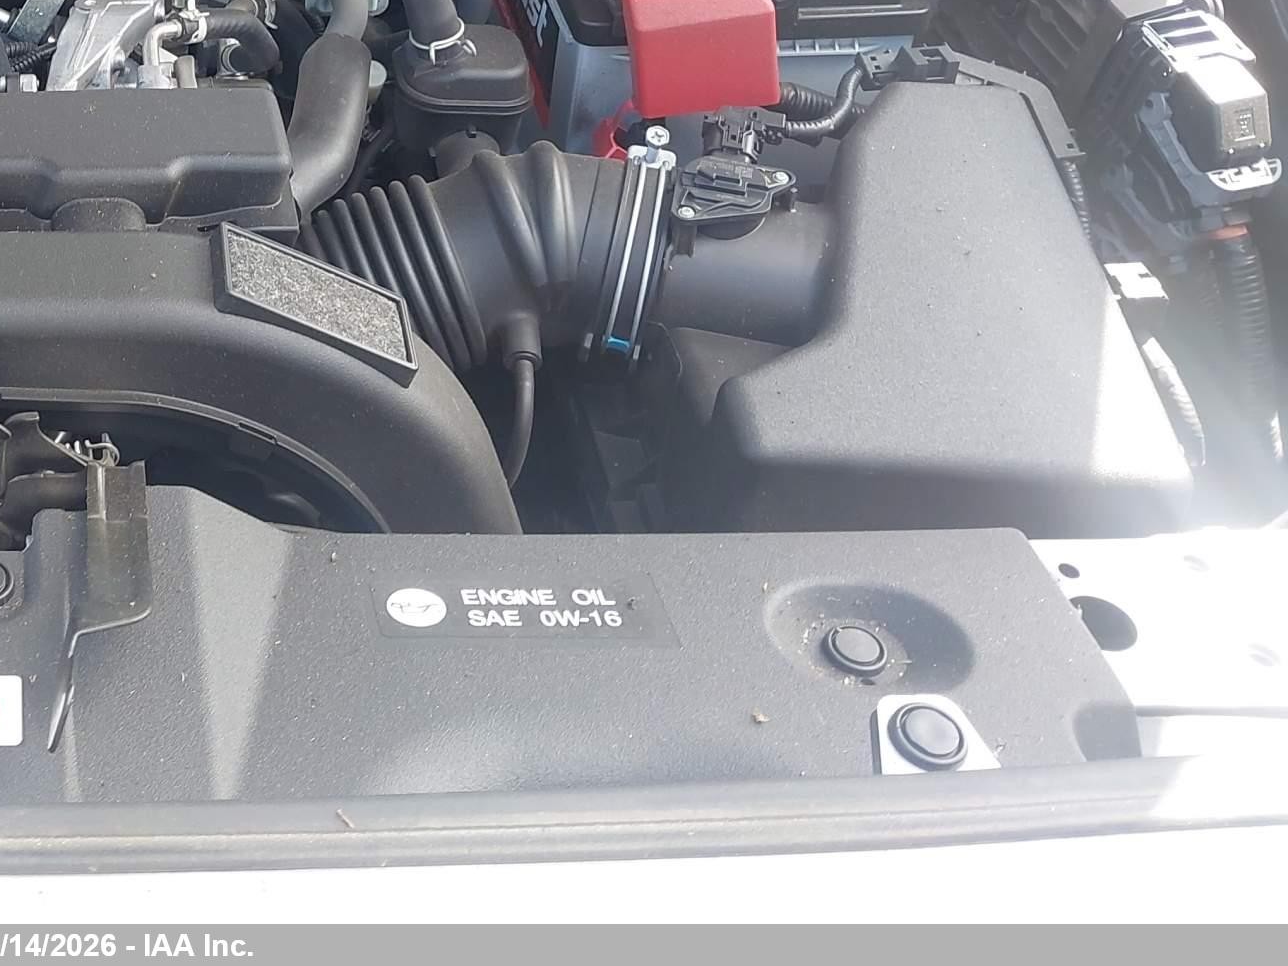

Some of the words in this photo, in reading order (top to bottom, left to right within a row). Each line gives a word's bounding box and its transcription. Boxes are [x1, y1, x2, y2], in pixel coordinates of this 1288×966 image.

[460, 588, 557, 606] ENGINE
[571, 589, 616, 606] OIL
[467, 609, 523, 627] SAE
[539, 609, 622, 627] 0W-16
